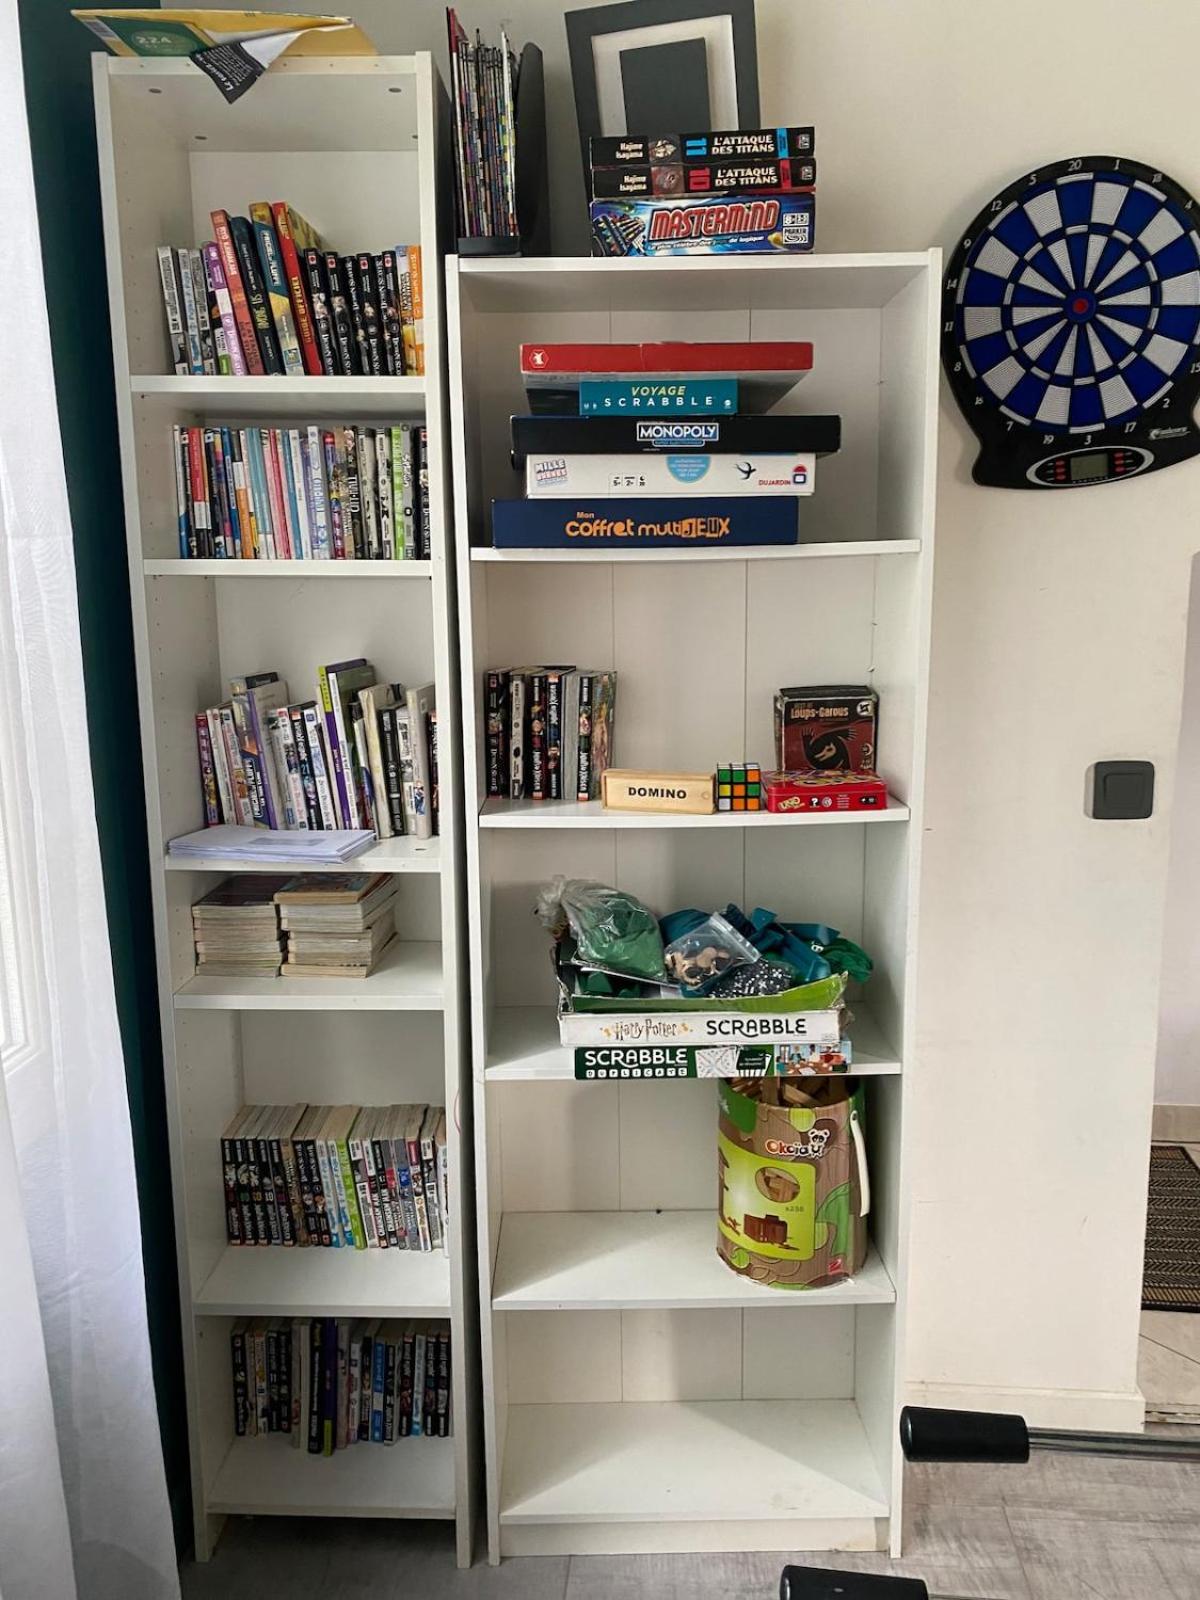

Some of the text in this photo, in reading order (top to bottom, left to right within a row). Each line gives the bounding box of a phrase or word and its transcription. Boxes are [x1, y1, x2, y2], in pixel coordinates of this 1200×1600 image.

[713, 135, 773, 147] L'ATTAQUE
[712, 143, 775, 155] DES TITANS
[1067, 159, 1083, 171] 20
[1114, 159, 1120, 170] 1
[717, 167, 776, 178] L'ATTAQUE
[715, 176, 778, 186] DES TITANS
[1029, 174, 1037, 185] 5
[991, 200, 1002, 211] 12
[1185, 200, 1193, 210] 4
[650, 200, 780, 240] MASTERMIND
[964, 238, 972, 249] 9
[946, 279, 958, 290] 14
[954, 362, 962, 372] 8
[631, 386, 686, 396] VOYAGE
[604, 397, 713, 407] SCRABBLE
[1163, 398, 1170, 408] 2
[639, 426, 716, 438] MONOPOLY
[1006, 421, 1013, 432] 7
[1125, 422, 1136, 433] 17
[1085, 435, 1091, 445] 3
[577, 511, 594, 519] Mon
[565, 518, 634, 537] coffret
[628, 786, 687, 800] DOMINO
[706, 1018, 807, 1038] SCRABBLE
[584, 1049, 688, 1068] SCRABBLE
[586, 1068, 688, 1078] DUPLICATE
